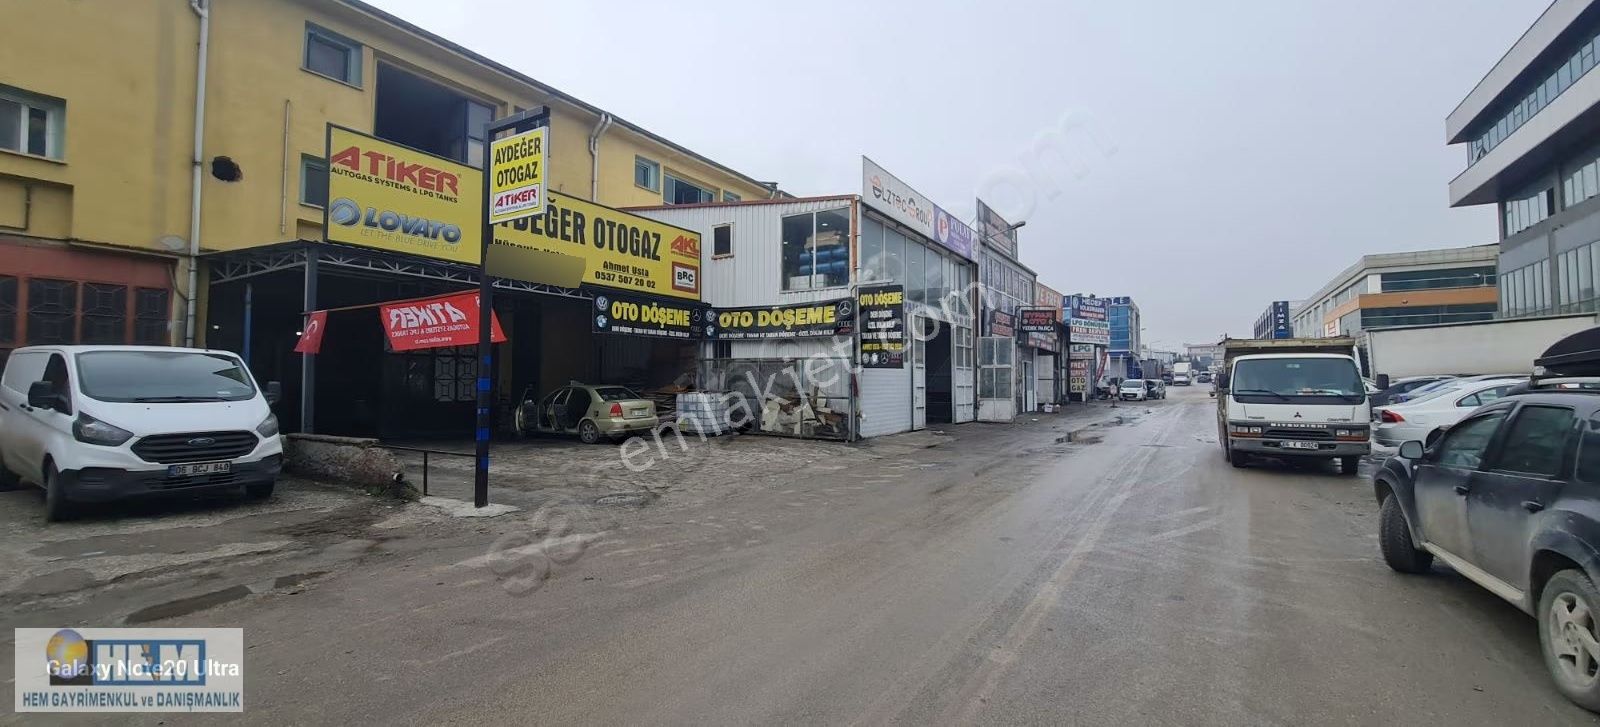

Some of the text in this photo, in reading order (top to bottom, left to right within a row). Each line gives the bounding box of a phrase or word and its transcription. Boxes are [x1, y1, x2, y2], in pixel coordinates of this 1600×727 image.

[494, 137, 541, 166] AYDEĞER
[331, 167, 376, 183] AUTOGAS
[374, 177, 411, 192] SYSTEMS
[436, 192, 458, 204] TANKS
[496, 161, 538, 187] OTOGAZ
[363, 207, 462, 244] LOVATO
[593, 217, 661, 261] OTOGAZ
[595, 271, 656, 289] 0537 507 20 02
[603, 261, 649, 277] Ahmet Usta
[677, 271, 694, 283] BRC
[611, 301, 691, 329] OTO DÖŞEME
[719, 311, 754, 328] OTO
